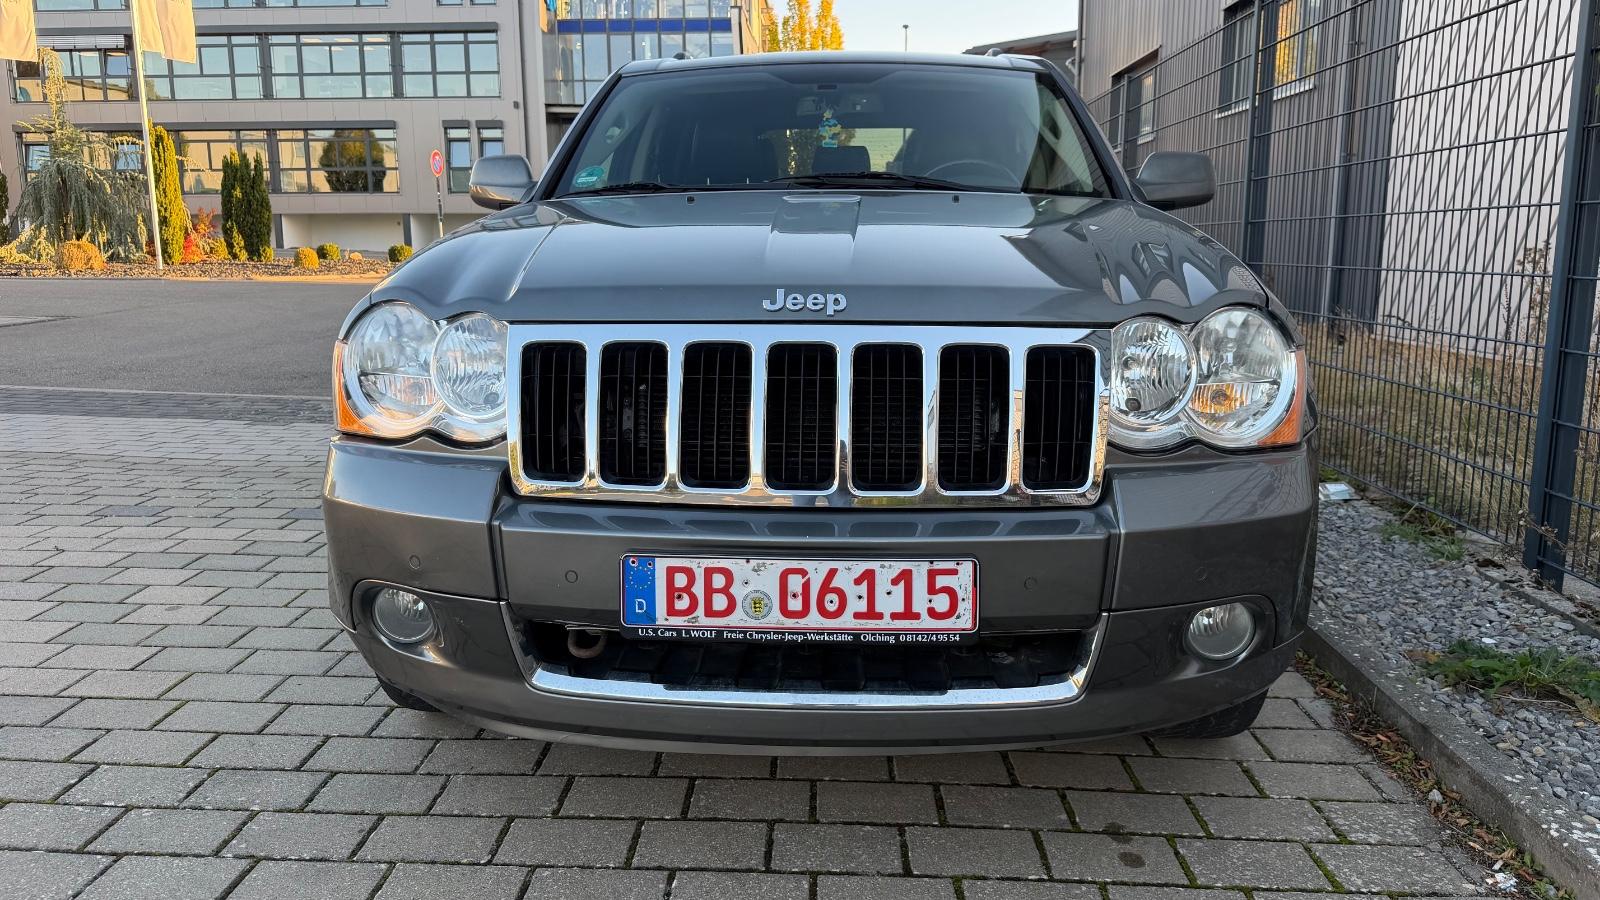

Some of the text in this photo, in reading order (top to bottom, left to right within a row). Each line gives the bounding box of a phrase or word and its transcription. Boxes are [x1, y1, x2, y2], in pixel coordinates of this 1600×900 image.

[762, 288, 847, 317] Jeep
[665, 565, 738, 618] BB
[778, 567, 959, 621] 06115
[635, 598, 647, 613] D
[638, 628, 656, 637] U.S.
[657, 628, 677, 637] Cars
[723, 630, 745, 639] Freie
[746, 630, 854, 643] Chrysler-Jeep-Werkstätte
[860, 632, 896, 644] Olching
